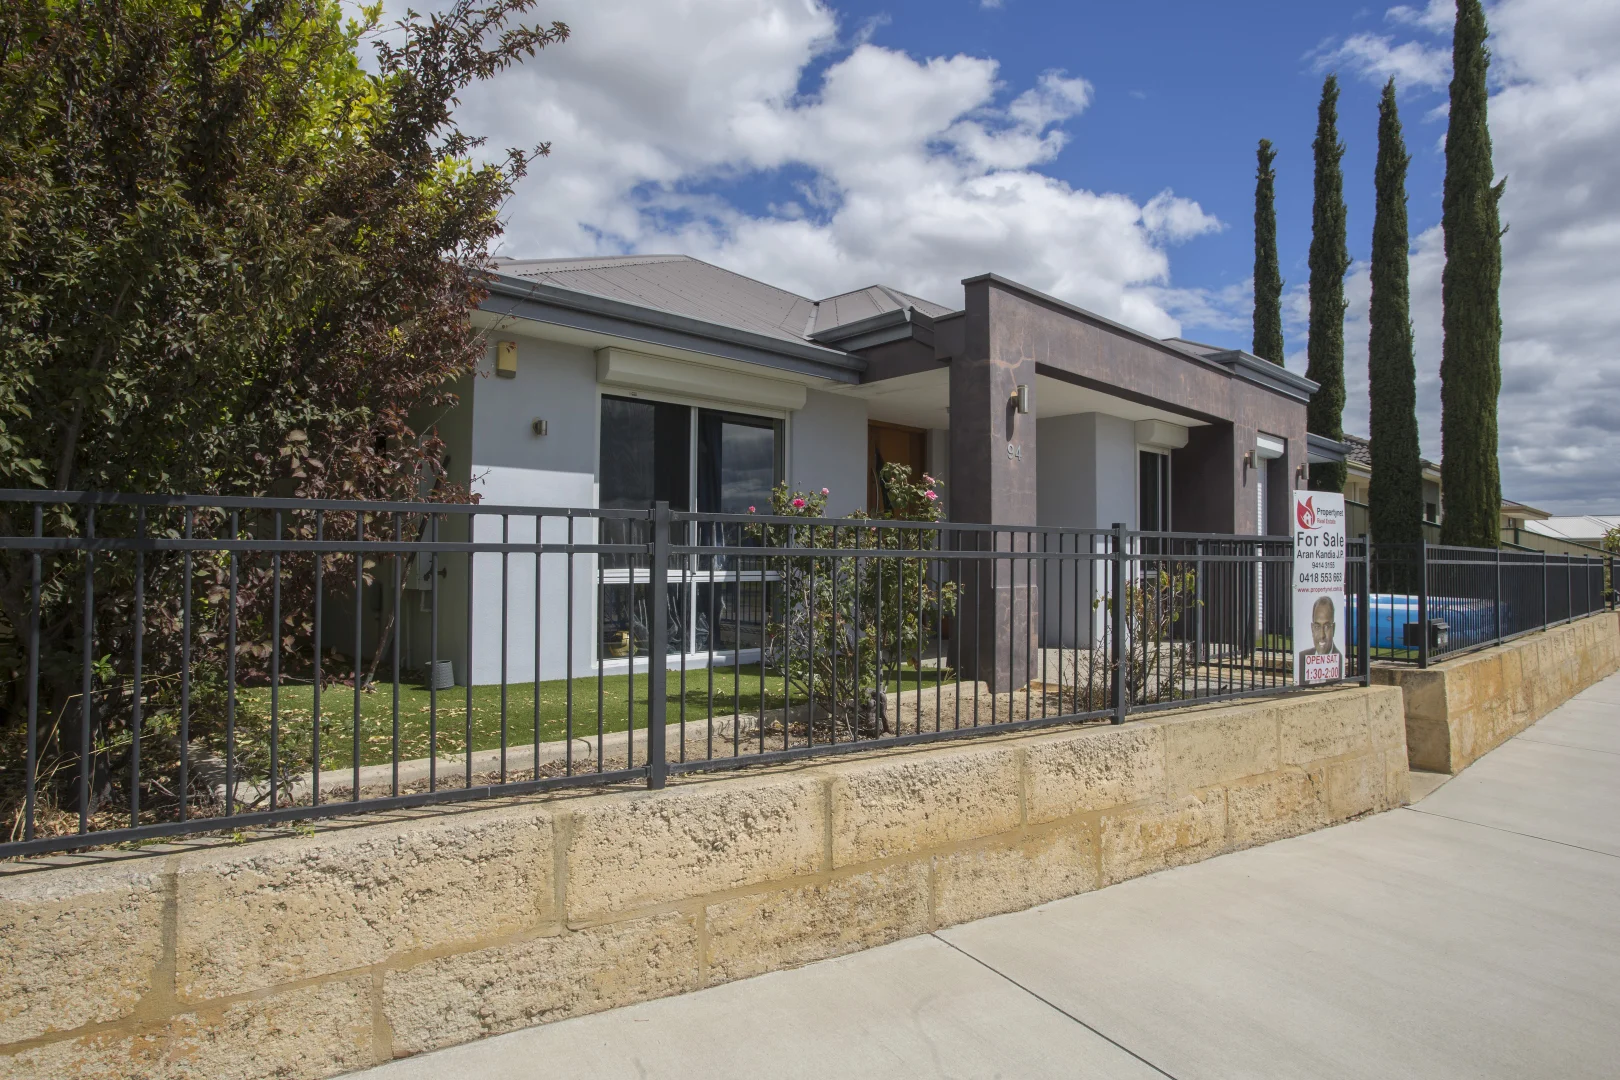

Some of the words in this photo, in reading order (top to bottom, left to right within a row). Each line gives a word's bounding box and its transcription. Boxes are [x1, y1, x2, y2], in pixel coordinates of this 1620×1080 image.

[1007, 443, 1022, 461] 94
[1316, 507, 1344, 518] Propertynet
[1297, 531, 1318, 547] For
[1323, 532, 1344, 547] Sale
[1297, 550, 1314, 558] Aran
[1300, 572, 1318, 582] 0418
[1320, 572, 1332, 582] 553
[1306, 656, 1325, 664] OPEN
[1306, 667, 1339, 680] 1:30-2:00
